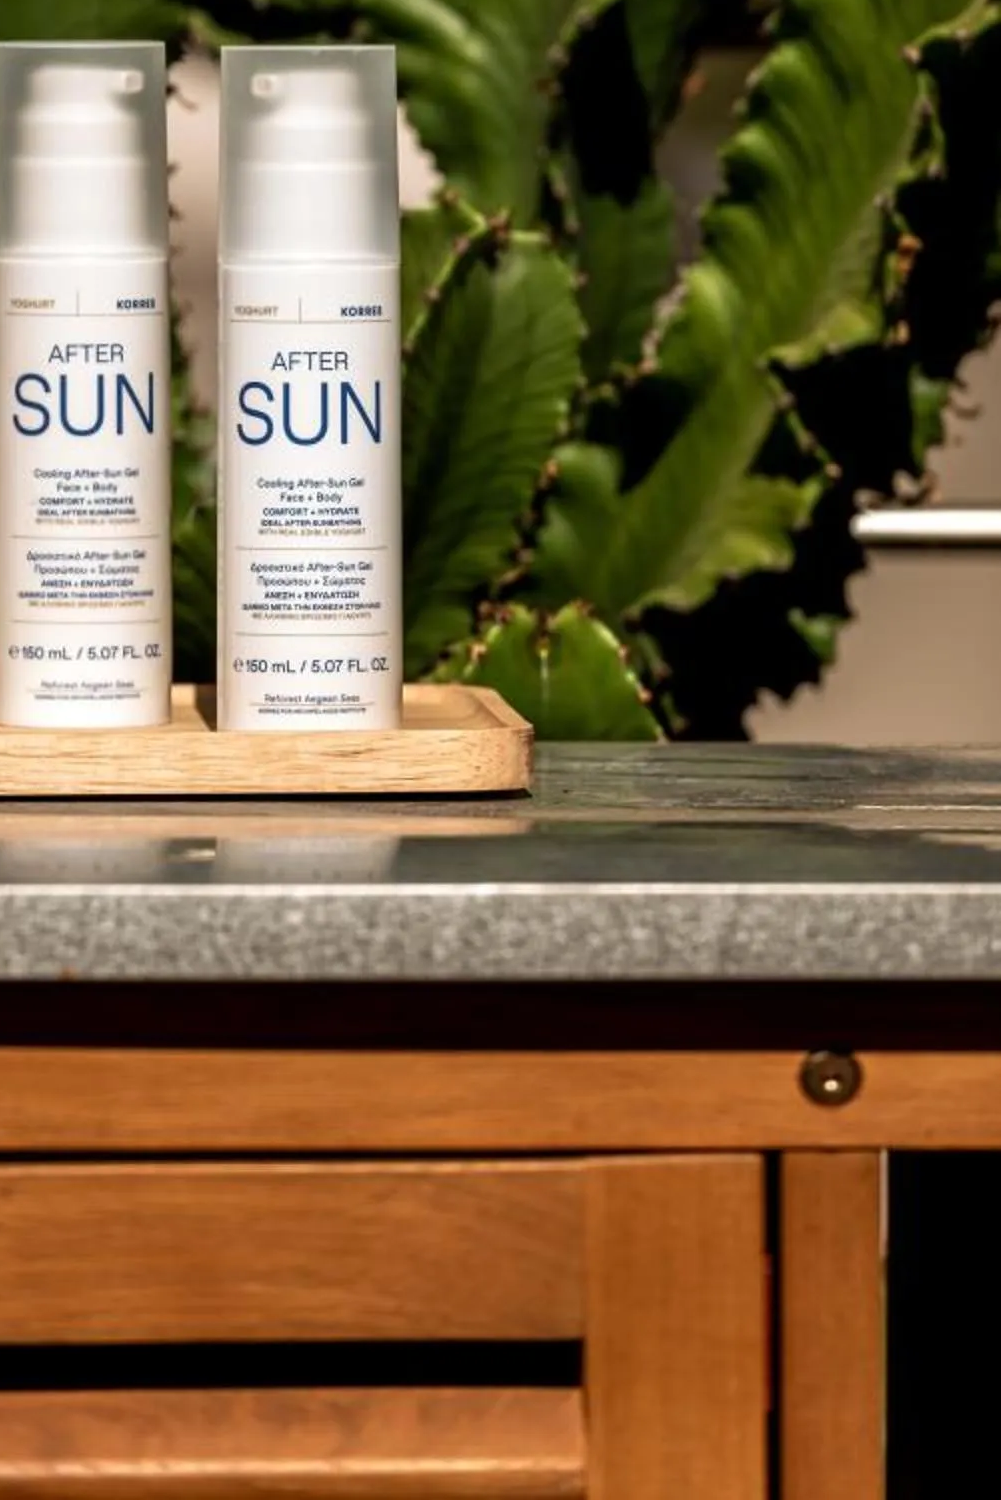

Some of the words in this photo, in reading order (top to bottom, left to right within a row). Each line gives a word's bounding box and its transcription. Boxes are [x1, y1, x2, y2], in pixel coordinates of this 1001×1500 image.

[11, 299, 55, 309] YOGHURT
[117, 298, 156, 310] KORRES
[234, 305, 279, 317] YOGHURT
[341, 305, 382, 317] KORRES
[48, 343, 125, 363] AFTER
[271, 351, 349, 371] AFTER
[13, 371, 154, 436] SUN
[237, 379, 381, 446] SUN
[33, 468, 72, 480] Cooling
[57, 482, 81, 492] Face
[92, 482, 117, 493] Body
[257, 478, 294, 490] Cooling
[297, 478, 347, 488] After-Sun
[280, 492, 304, 502] Face
[317, 492, 343, 504] Body
[263, 507, 308, 516] COMFORT
[318, 507, 359, 516] HYDRATE
[48, 646, 72, 660] mL
[76, 647, 83, 660] /
[87, 646, 118, 660] 5.07
[272, 659, 295, 673] mL
[300, 659, 307, 673] /
[310, 659, 343, 673] 5.07
